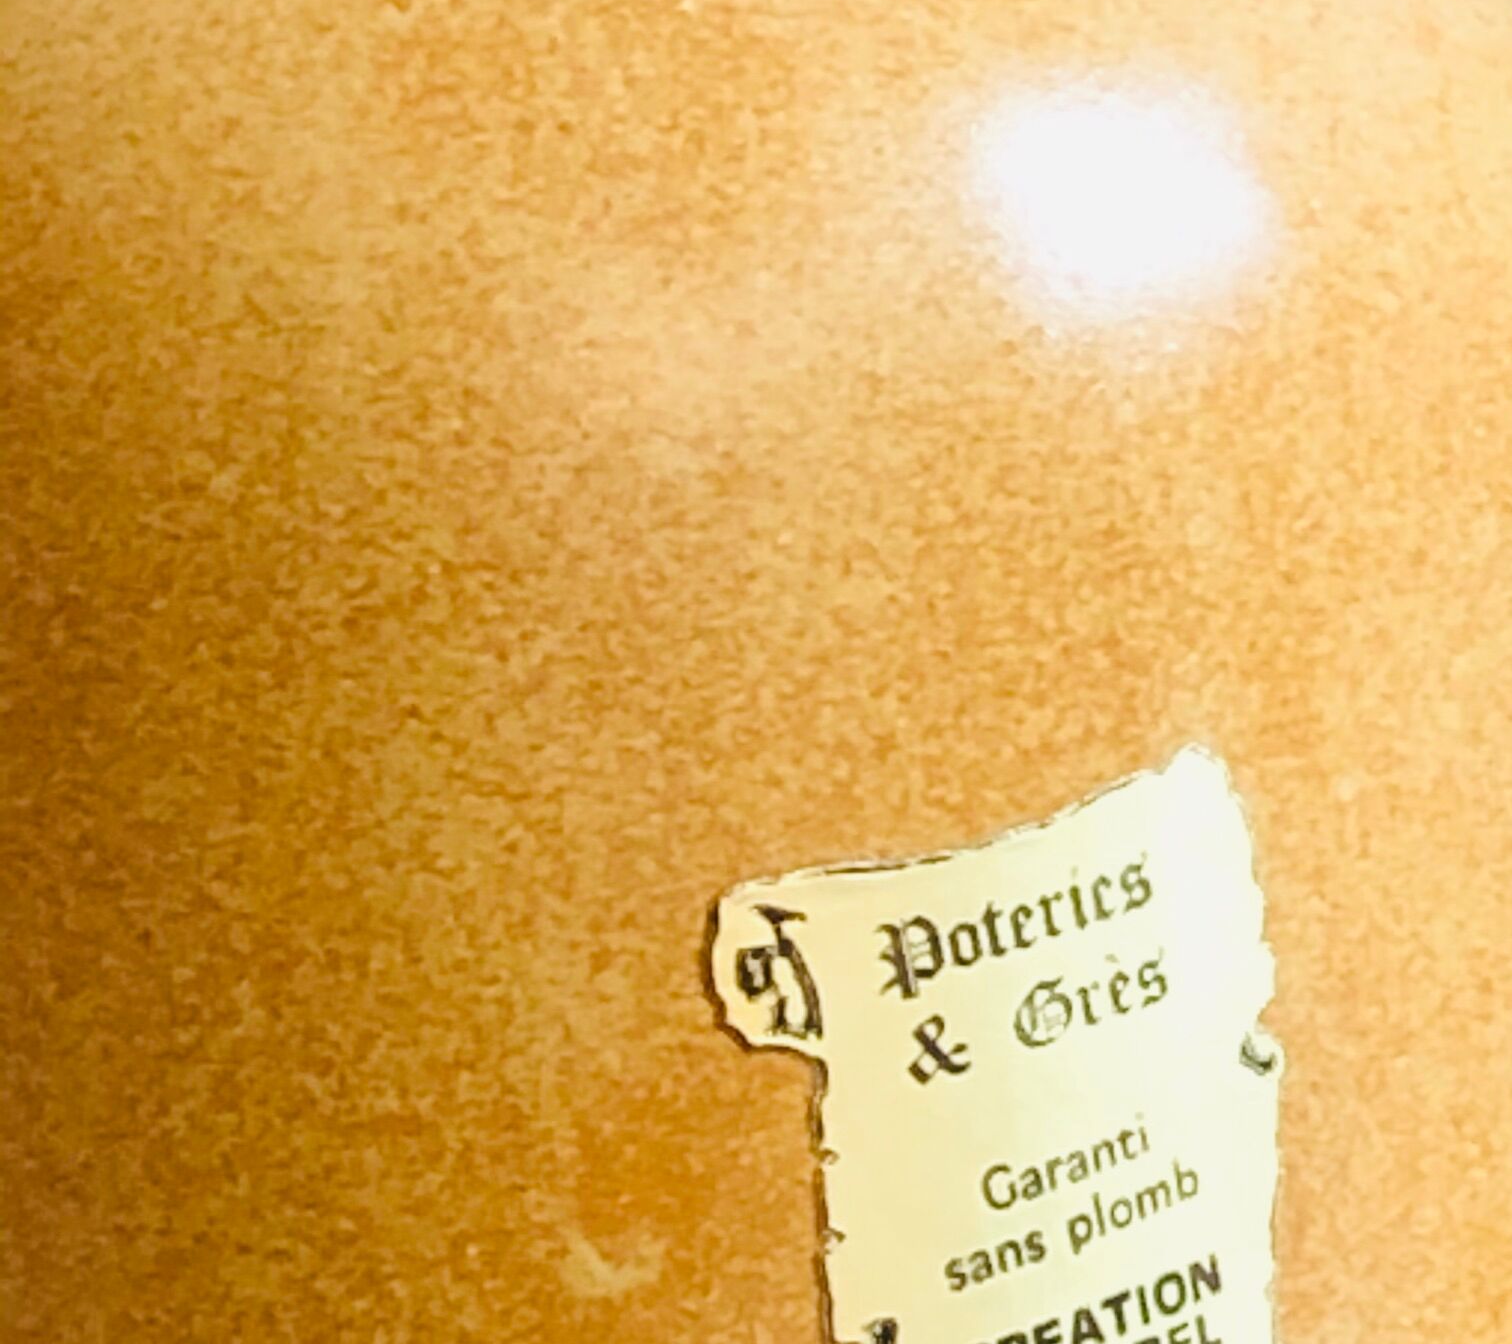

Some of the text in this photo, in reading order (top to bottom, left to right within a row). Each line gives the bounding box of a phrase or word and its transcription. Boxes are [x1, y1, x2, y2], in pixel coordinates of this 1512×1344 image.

[875, 852, 1154, 1000] Poteries
[907, 948, 1169, 1086] & Grès
[944, 1161, 1200, 1293] sans plomb
[981, 1114, 1151, 1211] Garanti
